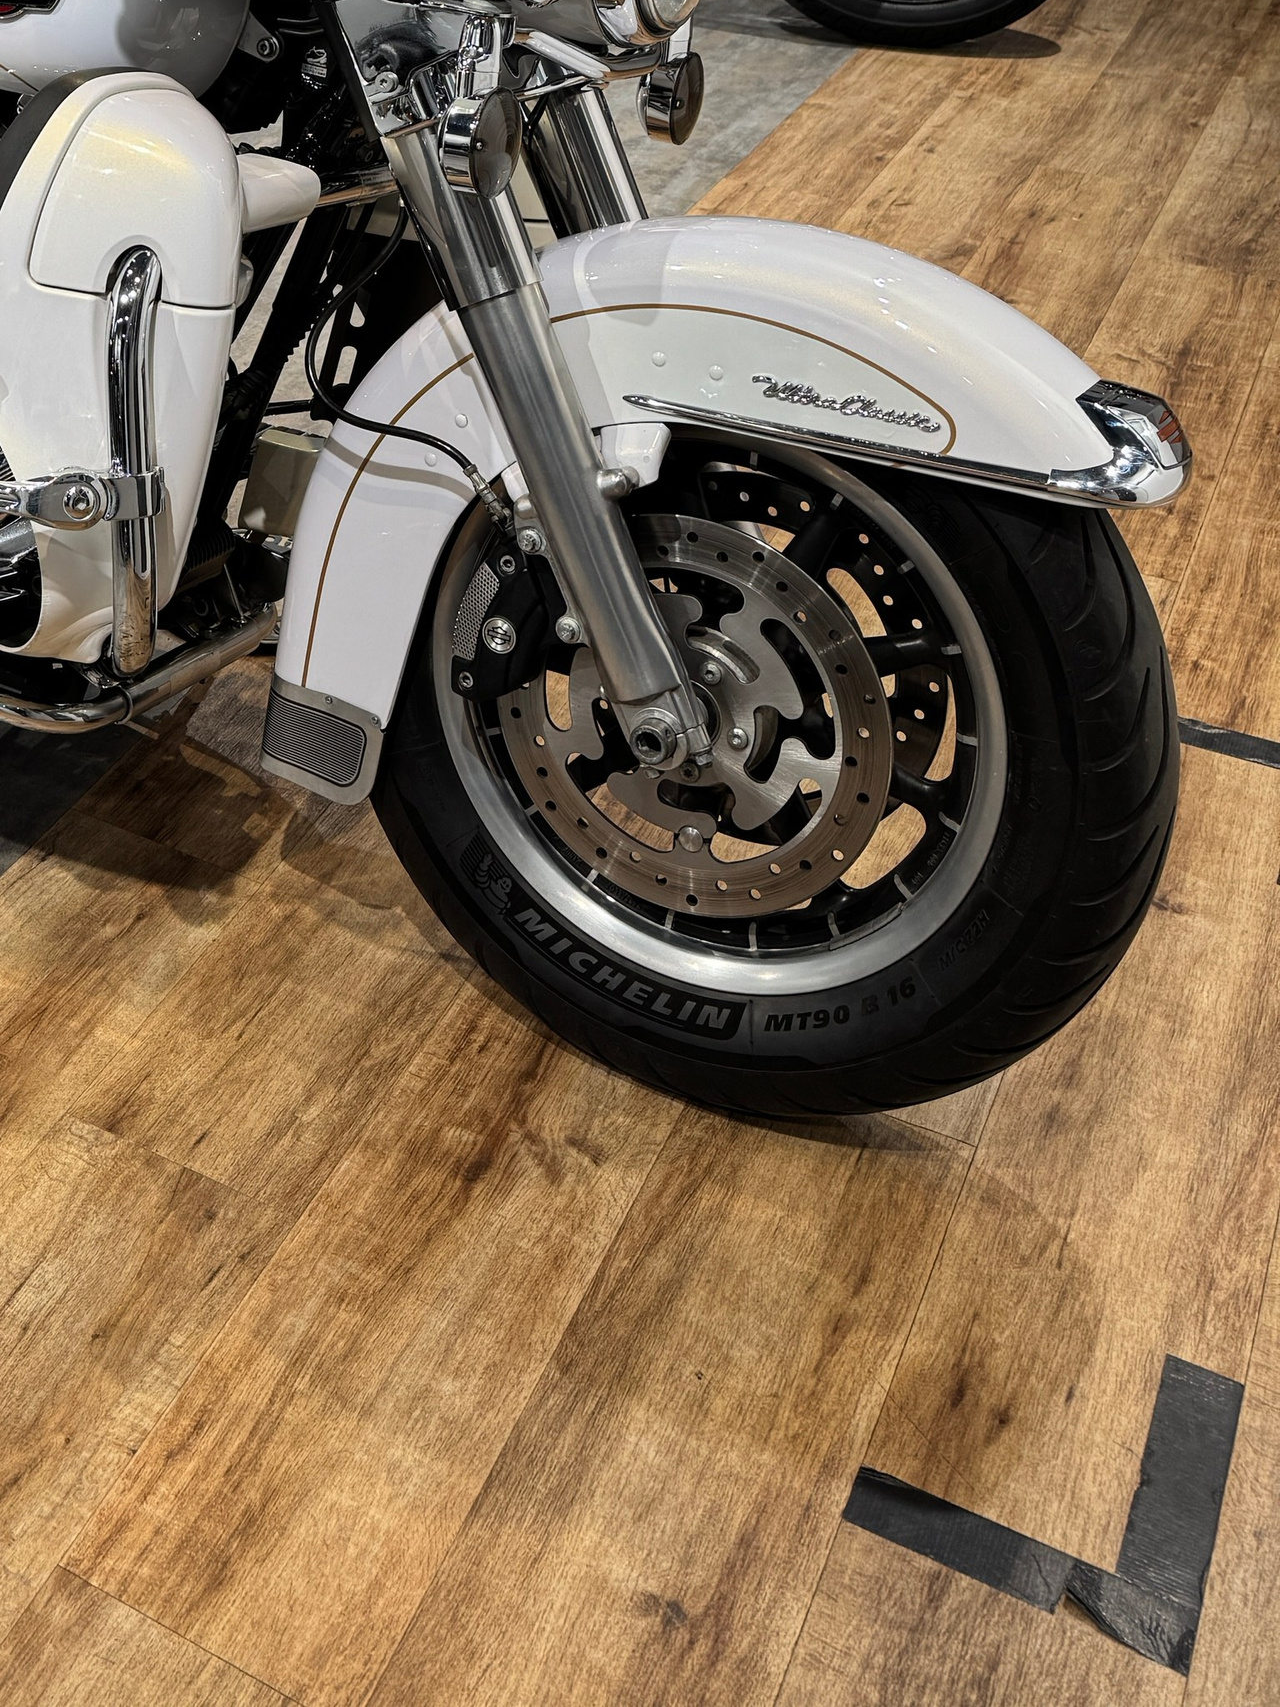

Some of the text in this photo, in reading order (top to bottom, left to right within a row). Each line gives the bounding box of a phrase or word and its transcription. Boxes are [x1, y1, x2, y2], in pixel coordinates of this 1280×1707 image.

[513, 907, 732, 1031] MICHELIN
[764, 1005, 850, 1032] MT90
[886, 976, 916, 1006] 16
